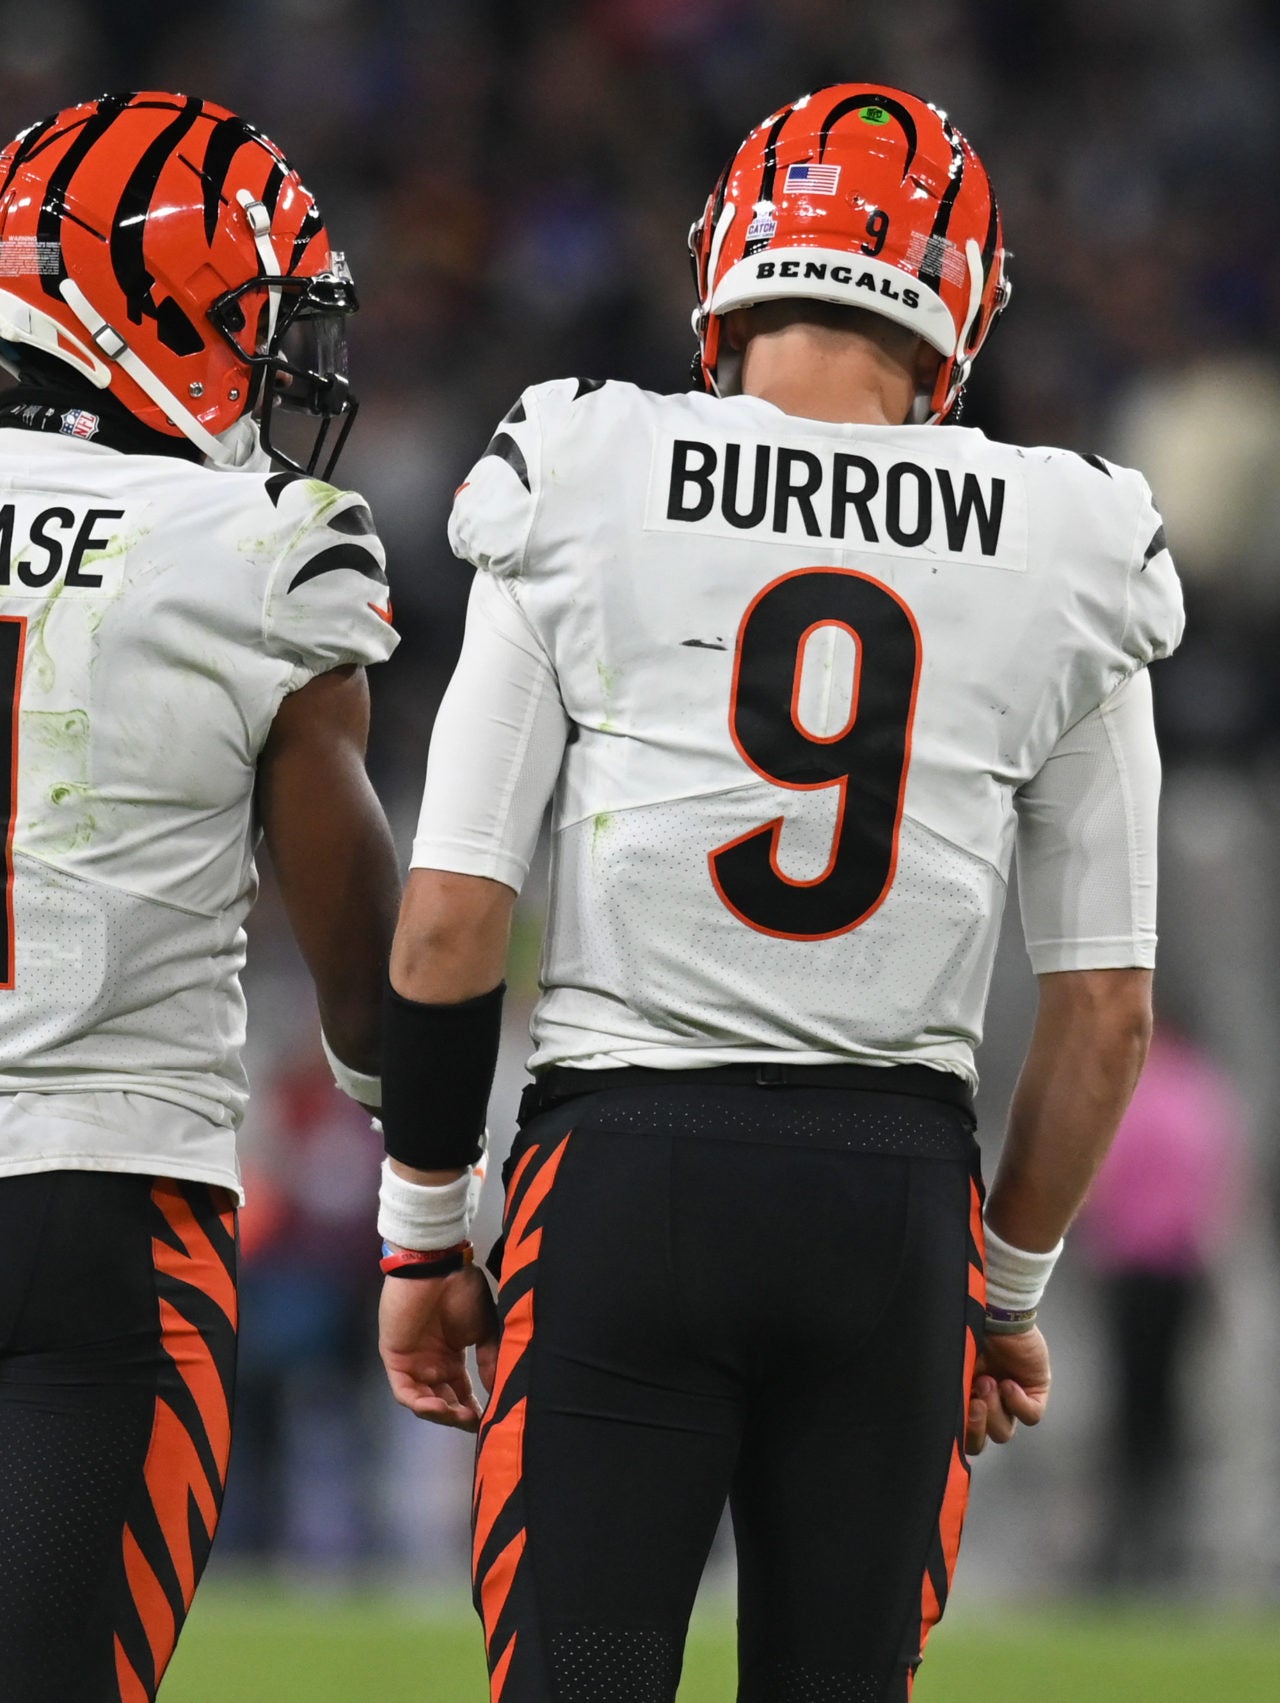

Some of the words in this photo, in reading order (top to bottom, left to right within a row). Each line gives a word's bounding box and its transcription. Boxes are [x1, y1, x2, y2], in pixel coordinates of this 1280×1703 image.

[748, 222, 776, 235] CATCH
[861, 210, 890, 257] 9
[756, 261, 921, 310] BENGALS
[73, 415, 96, 438] NFL
[666, 439, 1006, 557] BURROW
[707, 566, 923, 942] 9
